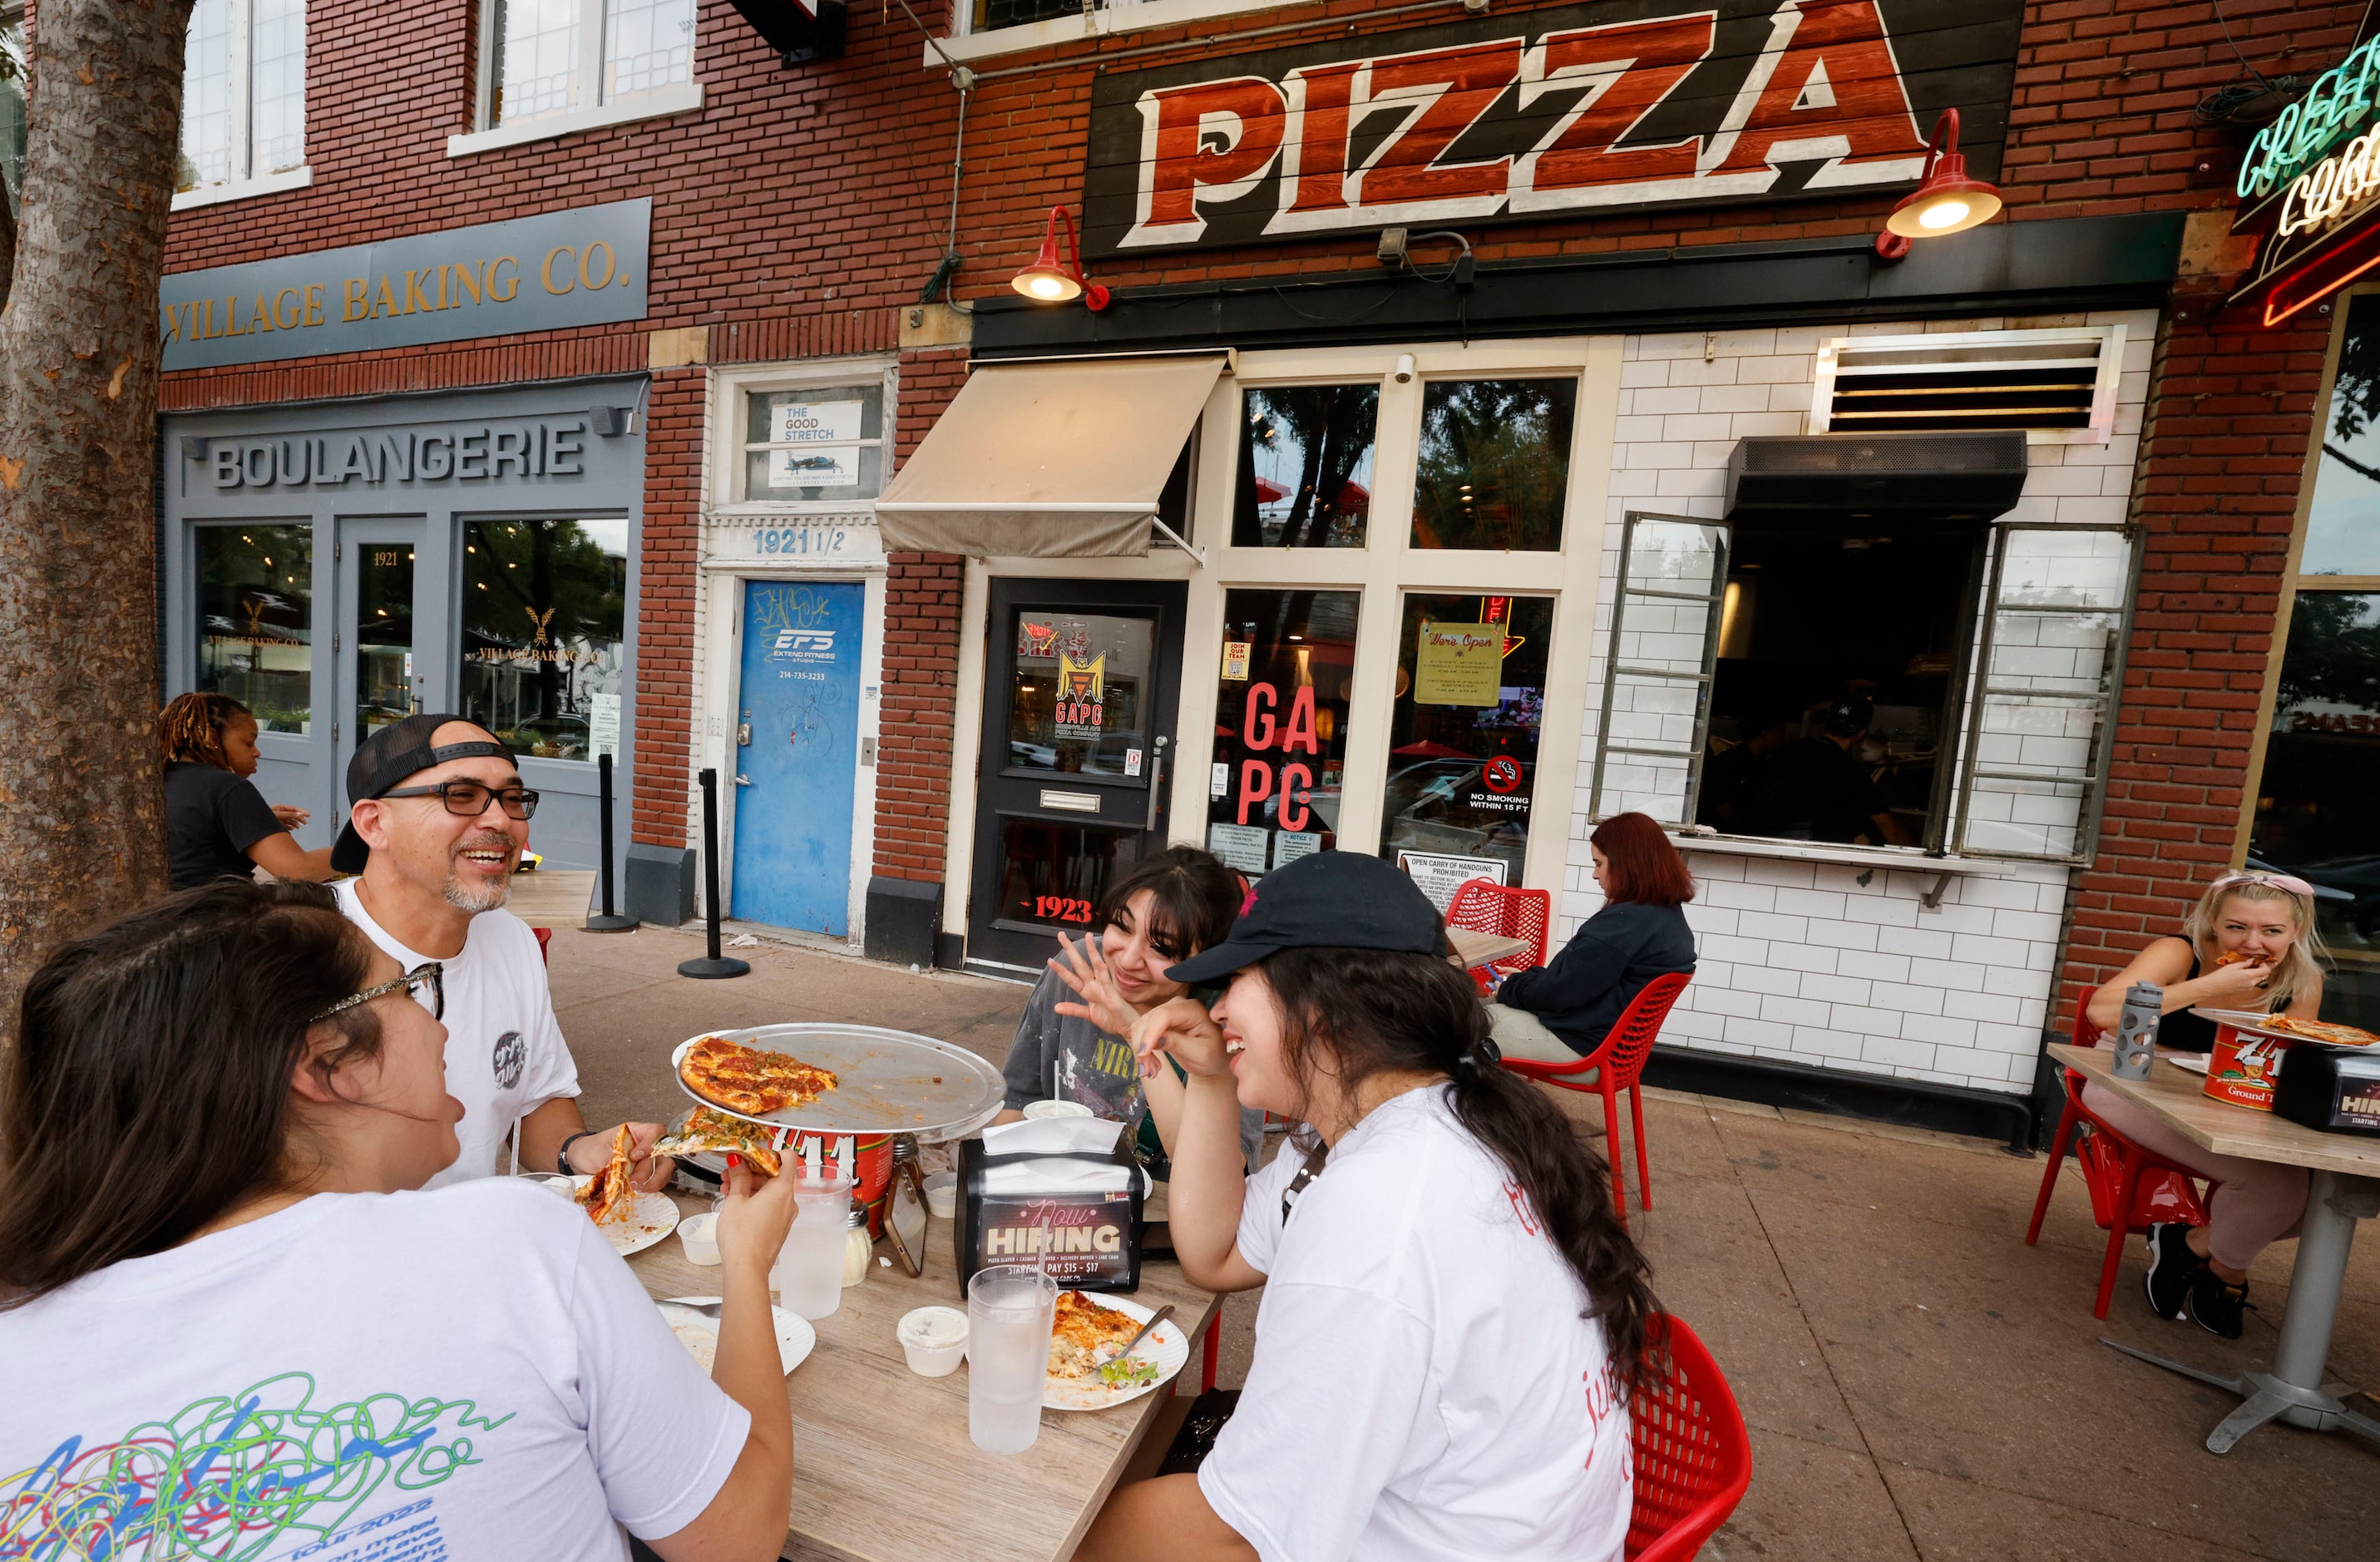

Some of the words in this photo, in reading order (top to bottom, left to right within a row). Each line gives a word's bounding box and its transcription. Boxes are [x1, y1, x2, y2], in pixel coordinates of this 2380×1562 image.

[1117, 0, 1942, 250] PIZZA
[165, 284, 325, 344] VILLAGE
[342, 256, 521, 323] BAKING
[541, 240, 630, 295] CO.
[787, 408, 807, 418] THE
[786, 418, 818, 429] GOOD
[785, 429, 834, 441] STRETCH
[212, 423, 583, 488] BOULANGERIE
[753, 529, 807, 554] 1921
[816, 527, 845, 556] 1/2
[373, 551, 398, 566] 1921
[774, 629, 837, 650] EFS
[1429, 633, 1458, 647] We're
[1463, 634, 1493, 651] Open
[480, 648, 528, 660] VILLAGE
[531, 649, 579, 663] BAKING
[804, 651, 836, 660] FITNESS
[779, 671, 825, 681] 214-735-3233
[1469, 801, 1502, 810] WITHIN
[1486, 794, 1529, 804] SMOKING
[1429, 860, 1449, 868] CARRY
[1459, 863, 1493, 872] HANDGUNS
[1433, 868, 1469, 877] PROHIBITED
[1034, 896, 1092, 923] 1923
[1089, 1038, 1138, 1080] NIR
[2229, 1085, 2265, 1102] Ground
[2342, 1095, 2380, 1115] HIR
[2351, 1118, 2378, 1126] STARTING
[1027, 1199, 1090, 1227] Now
[987, 1225, 1121, 1256] HIRING
[1008, 1263, 1040, 1275] STARTIN
[1047, 1263, 1063, 1273] PAY
[1064, 1263, 1078, 1273] $15
[1086, 1263, 1099, 1273] $17
[292, 1529, 353, 1561] tour
[355, 1498, 434, 1536] 2022
[366, 1515, 437, 1551] motel
[395, 1527, 440, 1550] ave
